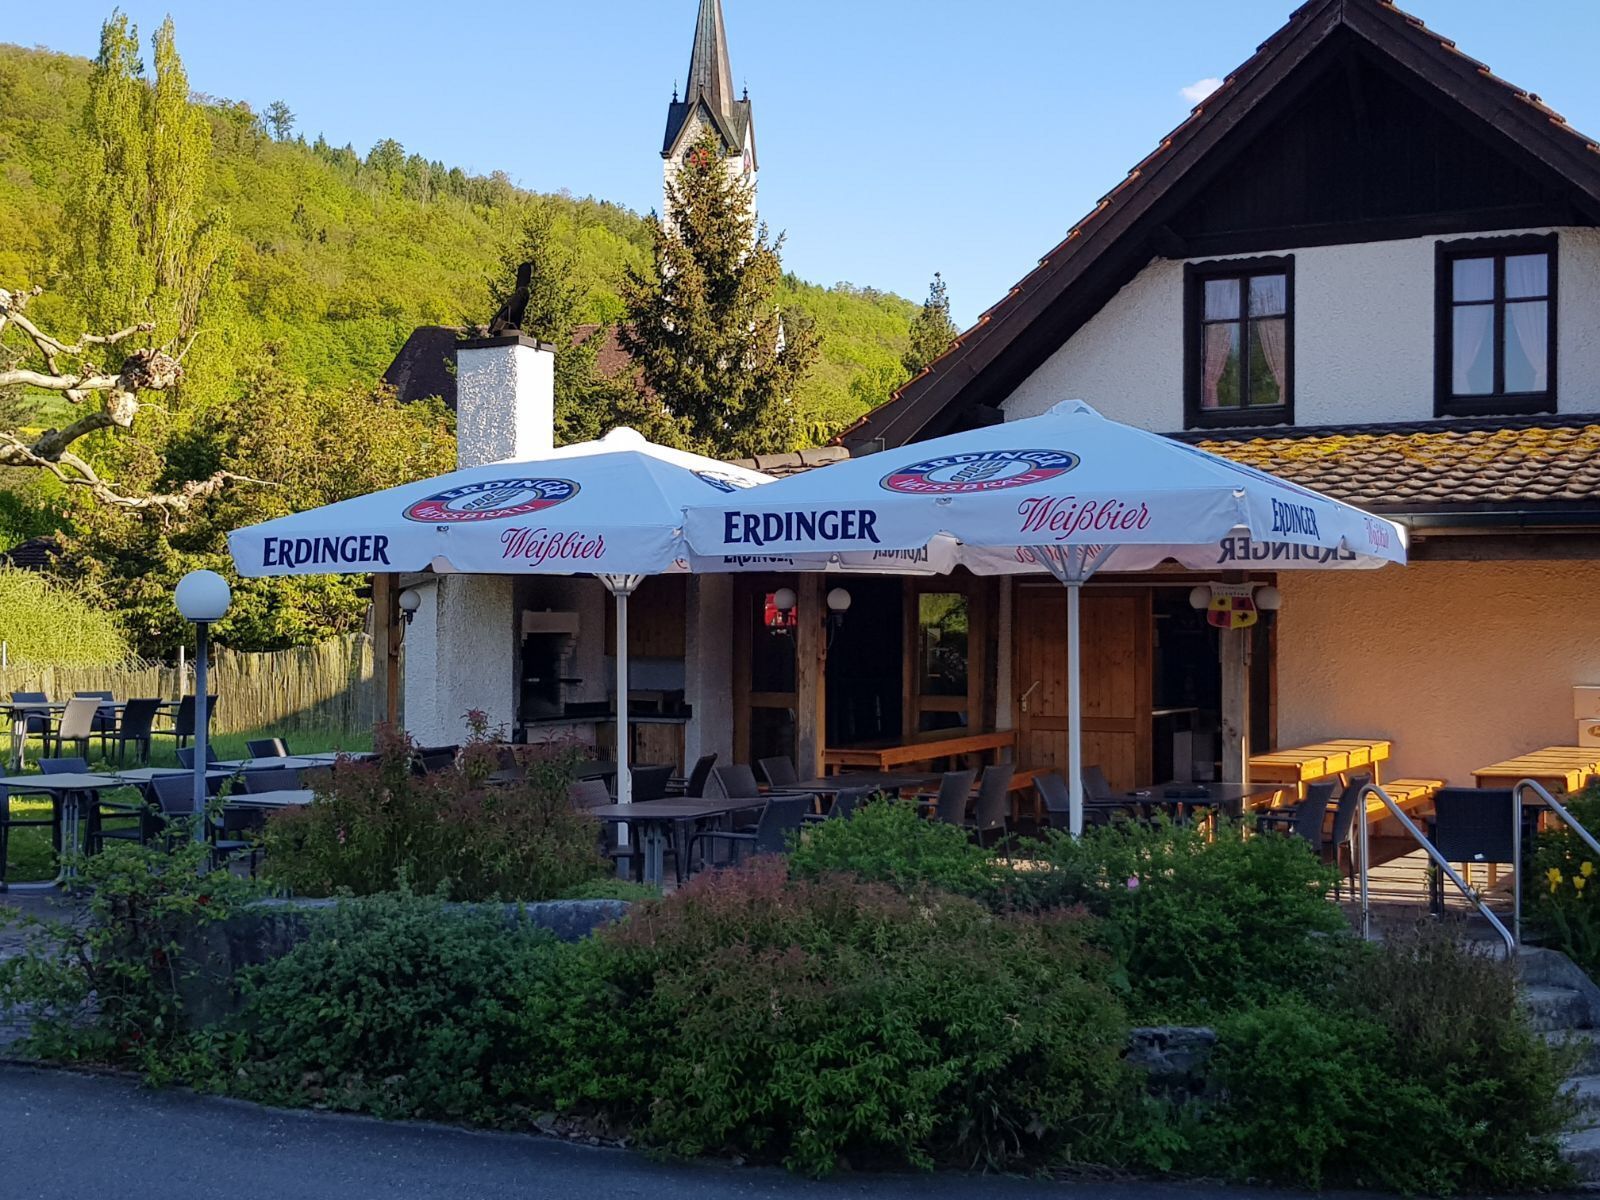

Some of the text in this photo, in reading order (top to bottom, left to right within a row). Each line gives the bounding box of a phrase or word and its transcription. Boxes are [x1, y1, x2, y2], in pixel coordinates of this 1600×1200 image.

[909, 452, 1068, 471] ERDINGER
[438, 480, 571, 498] ERDINGER
[723, 495, 1152, 546] ERDINGER Weißbier
[1271, 498, 1320, 540] ERDINGER
[263, 526, 607, 568] ERDINGER Weißbier
